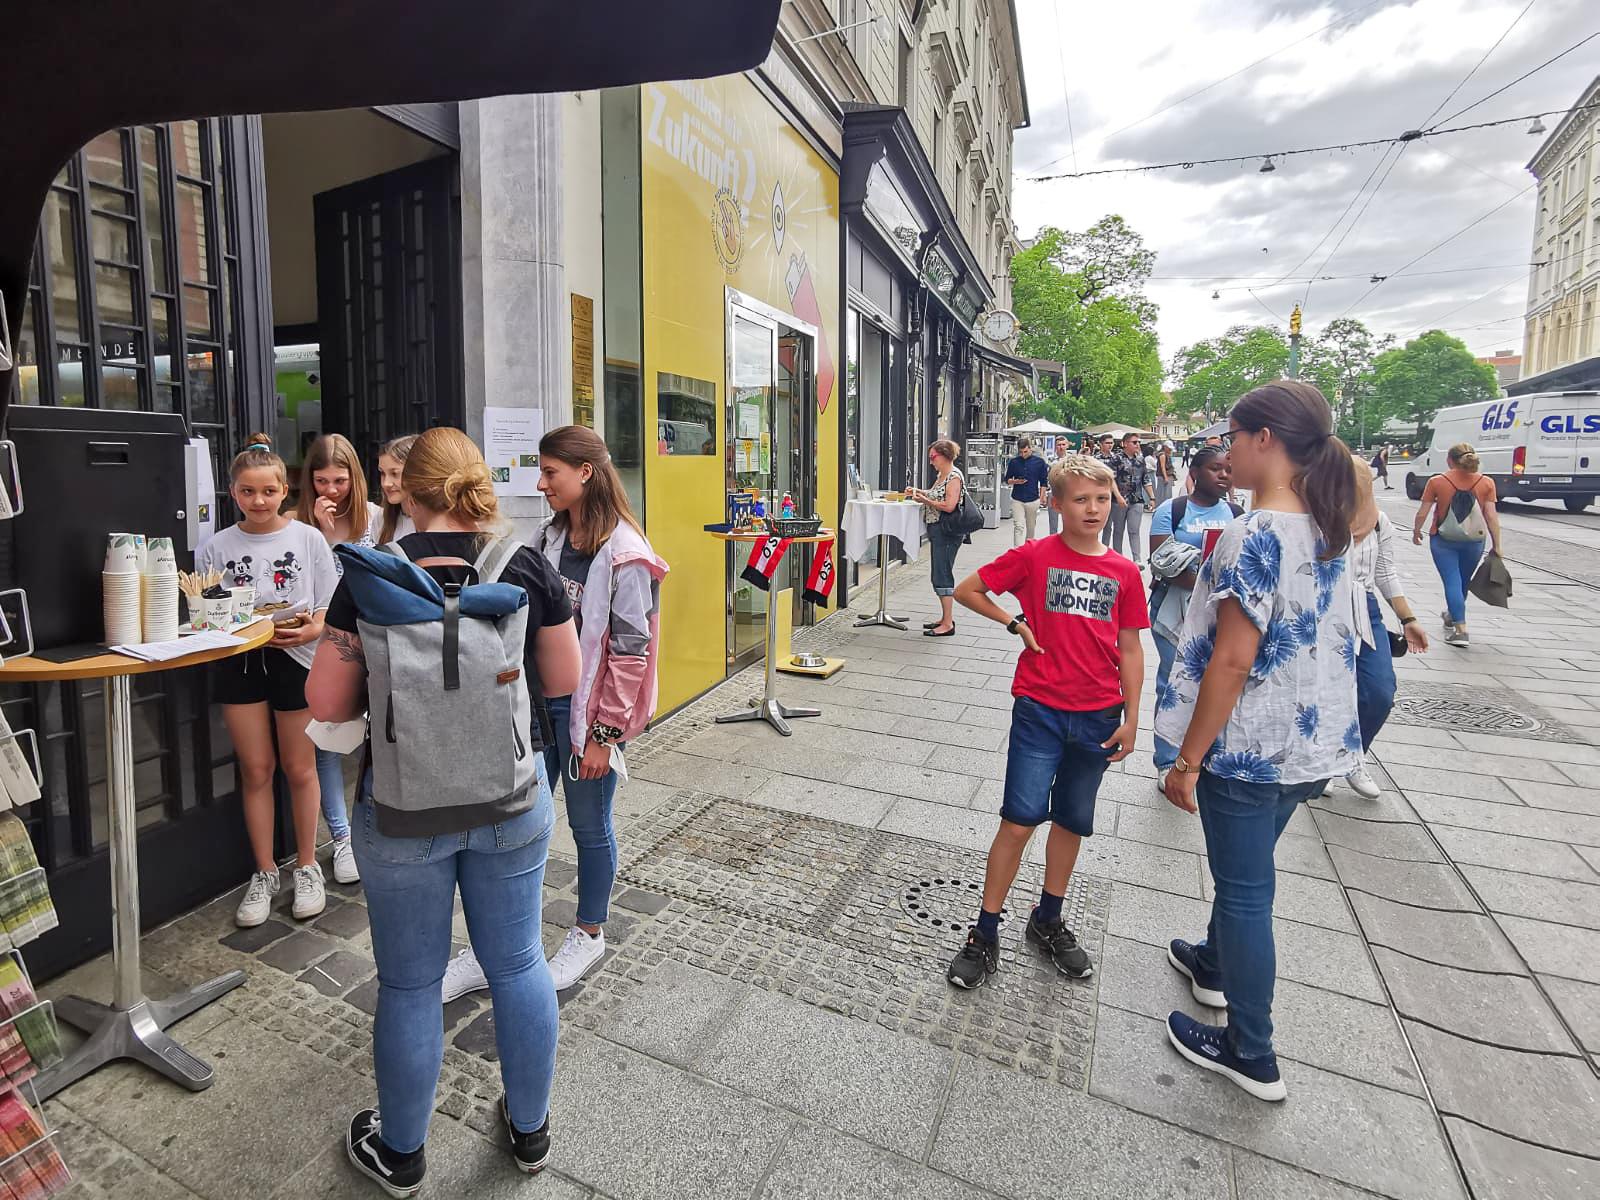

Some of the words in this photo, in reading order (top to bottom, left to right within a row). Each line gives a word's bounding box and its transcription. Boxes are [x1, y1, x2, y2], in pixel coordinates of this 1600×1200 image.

[1481, 400, 1519, 431] GLS
[1541, 414, 1600, 433] GLS
[1048, 592, 1110, 616] JONES
